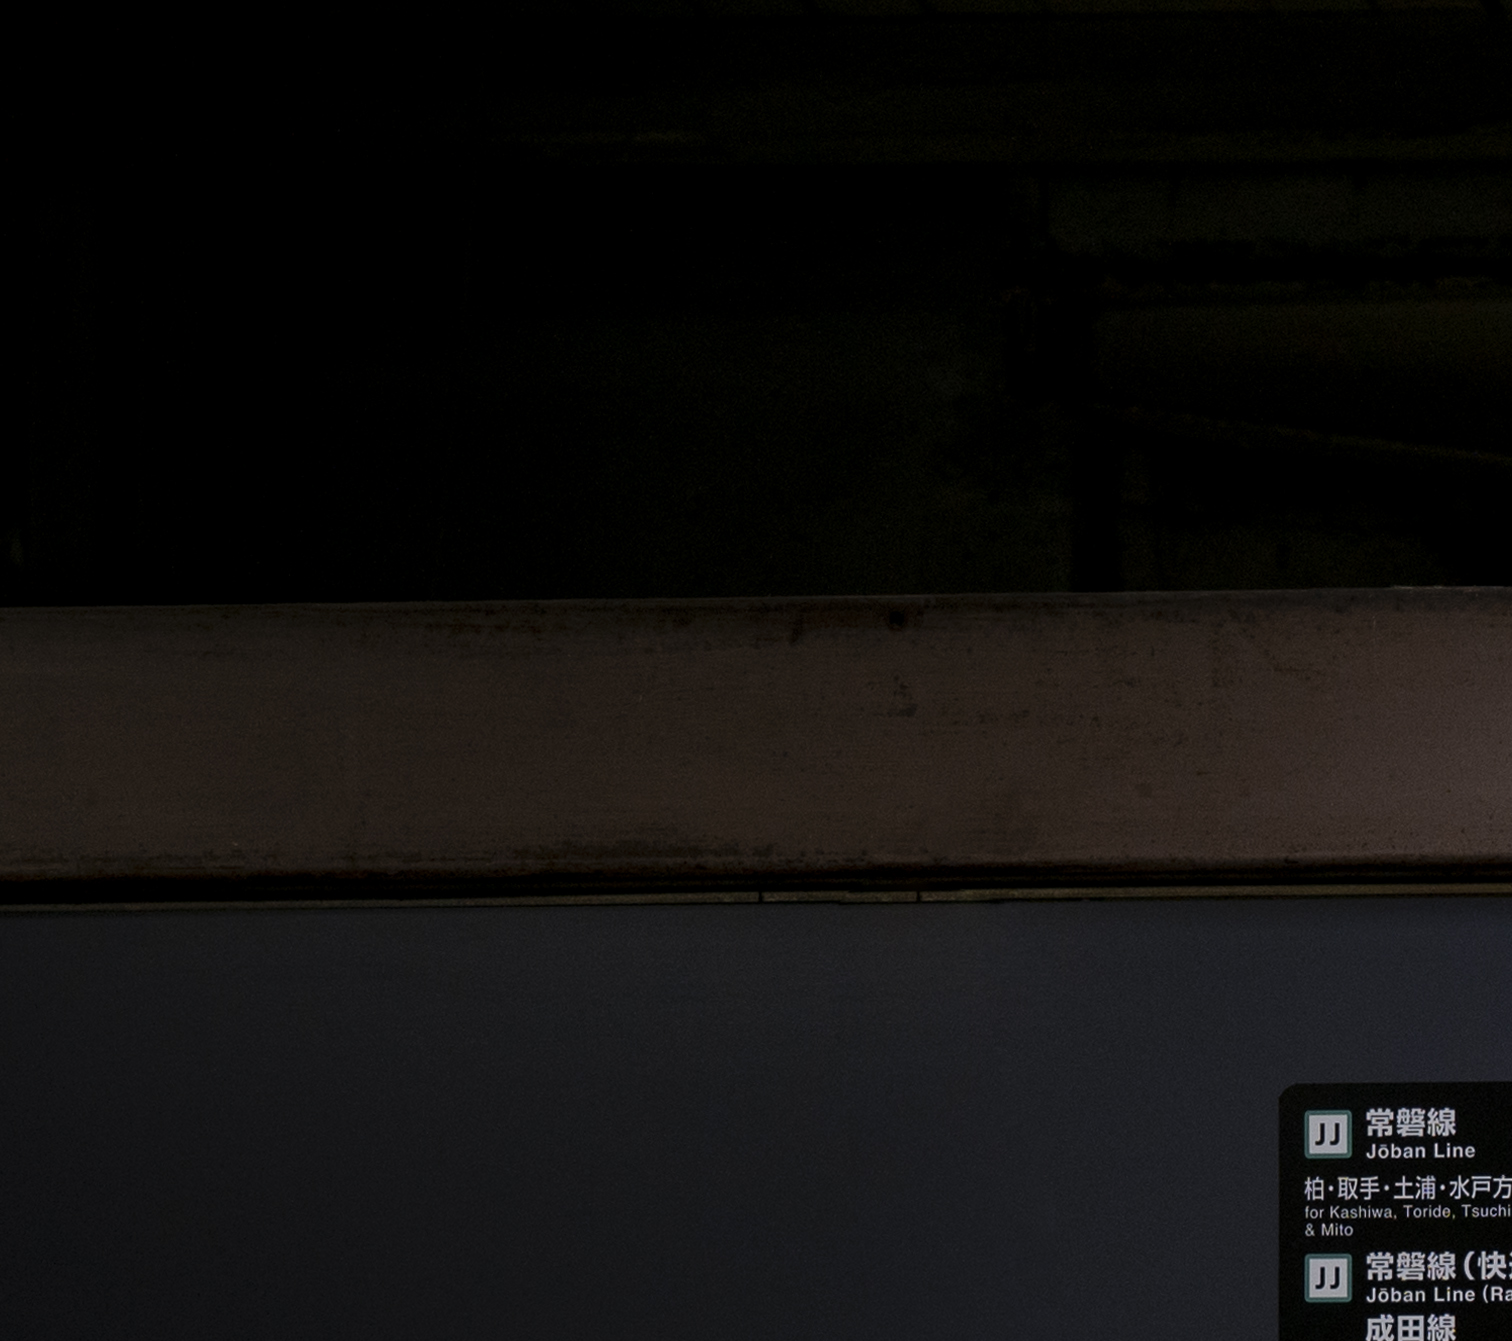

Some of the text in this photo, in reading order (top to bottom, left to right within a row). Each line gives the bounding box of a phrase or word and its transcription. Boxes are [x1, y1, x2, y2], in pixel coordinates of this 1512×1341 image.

[1366, 1108, 1456, 1137] 常磐線
[1315, 1123, 1340, 1146] JJ
[1366, 1143, 1475, 1159] Jōban Line
[1305, 1206, 1324, 1219] for
[1330, 1205, 1396, 1219] Kashiwa,
[1403, 1205, 1455, 1219] Toride,
[1305, 1223, 1353, 1236] & Mito
[1315, 1267, 1340, 1289] JJ
[1366, 1287, 1425, 1302] Jōban
[1434, 1287, 1475, 1301] Line
